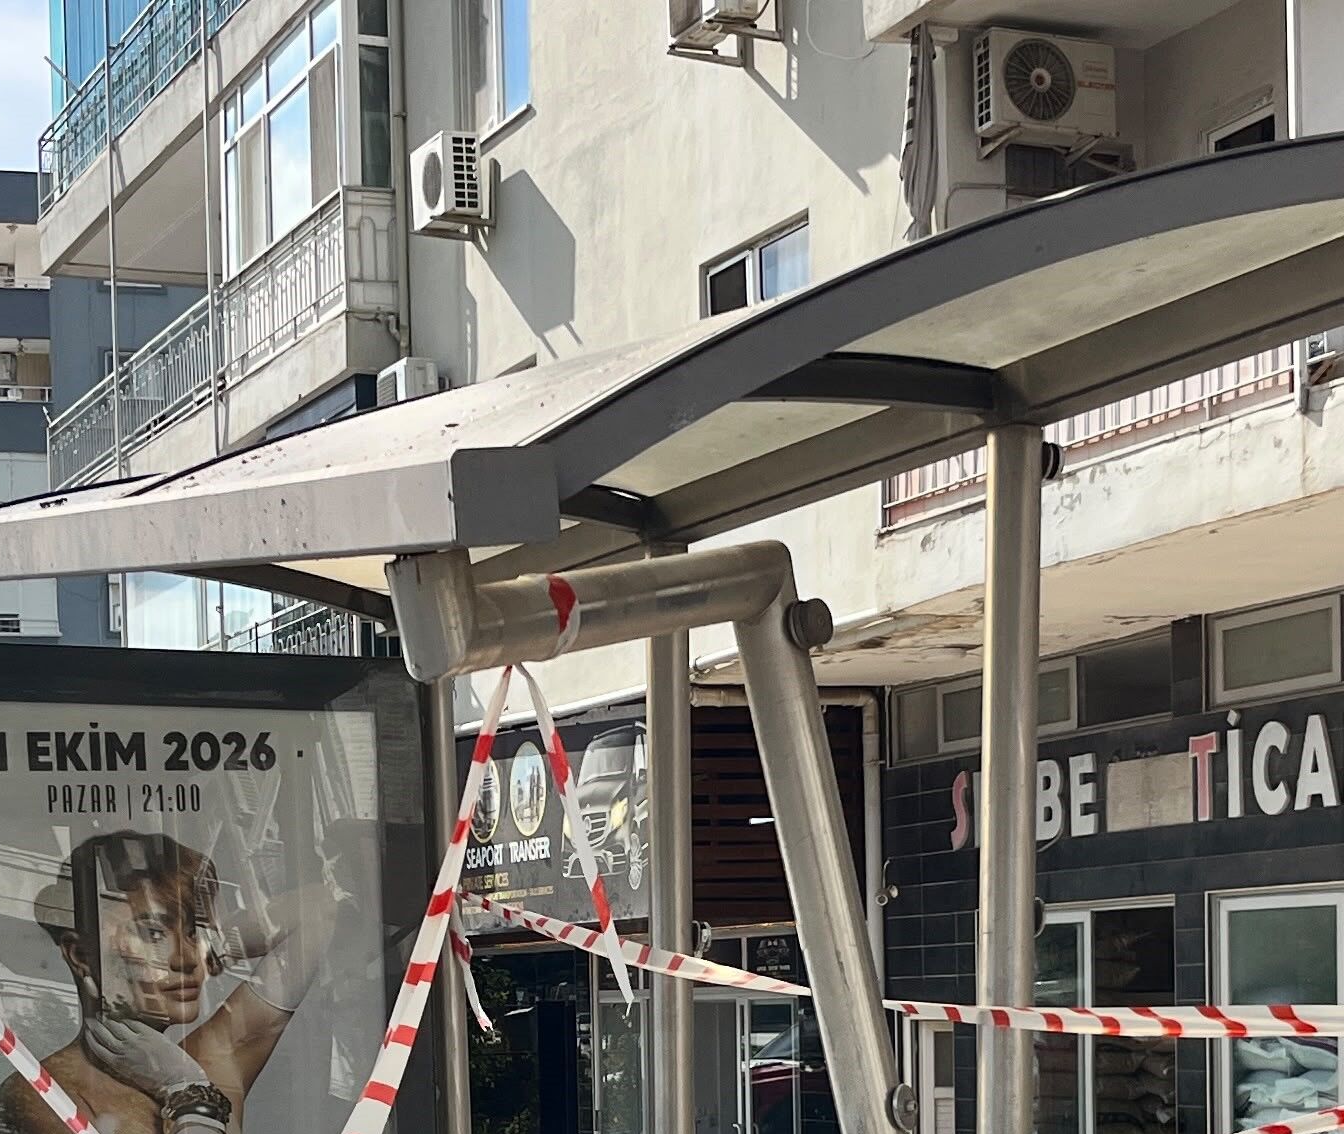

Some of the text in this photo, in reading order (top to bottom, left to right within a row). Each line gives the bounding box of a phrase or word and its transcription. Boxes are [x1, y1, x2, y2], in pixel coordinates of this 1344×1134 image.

[27, 722, 146, 772] EKİM
[163, 730, 277, 772] 2026
[47, 784, 117, 815] PAZAR
[141, 784, 202, 813] 21:00
[466, 836, 551, 870] SEAPORT TRANSFER
